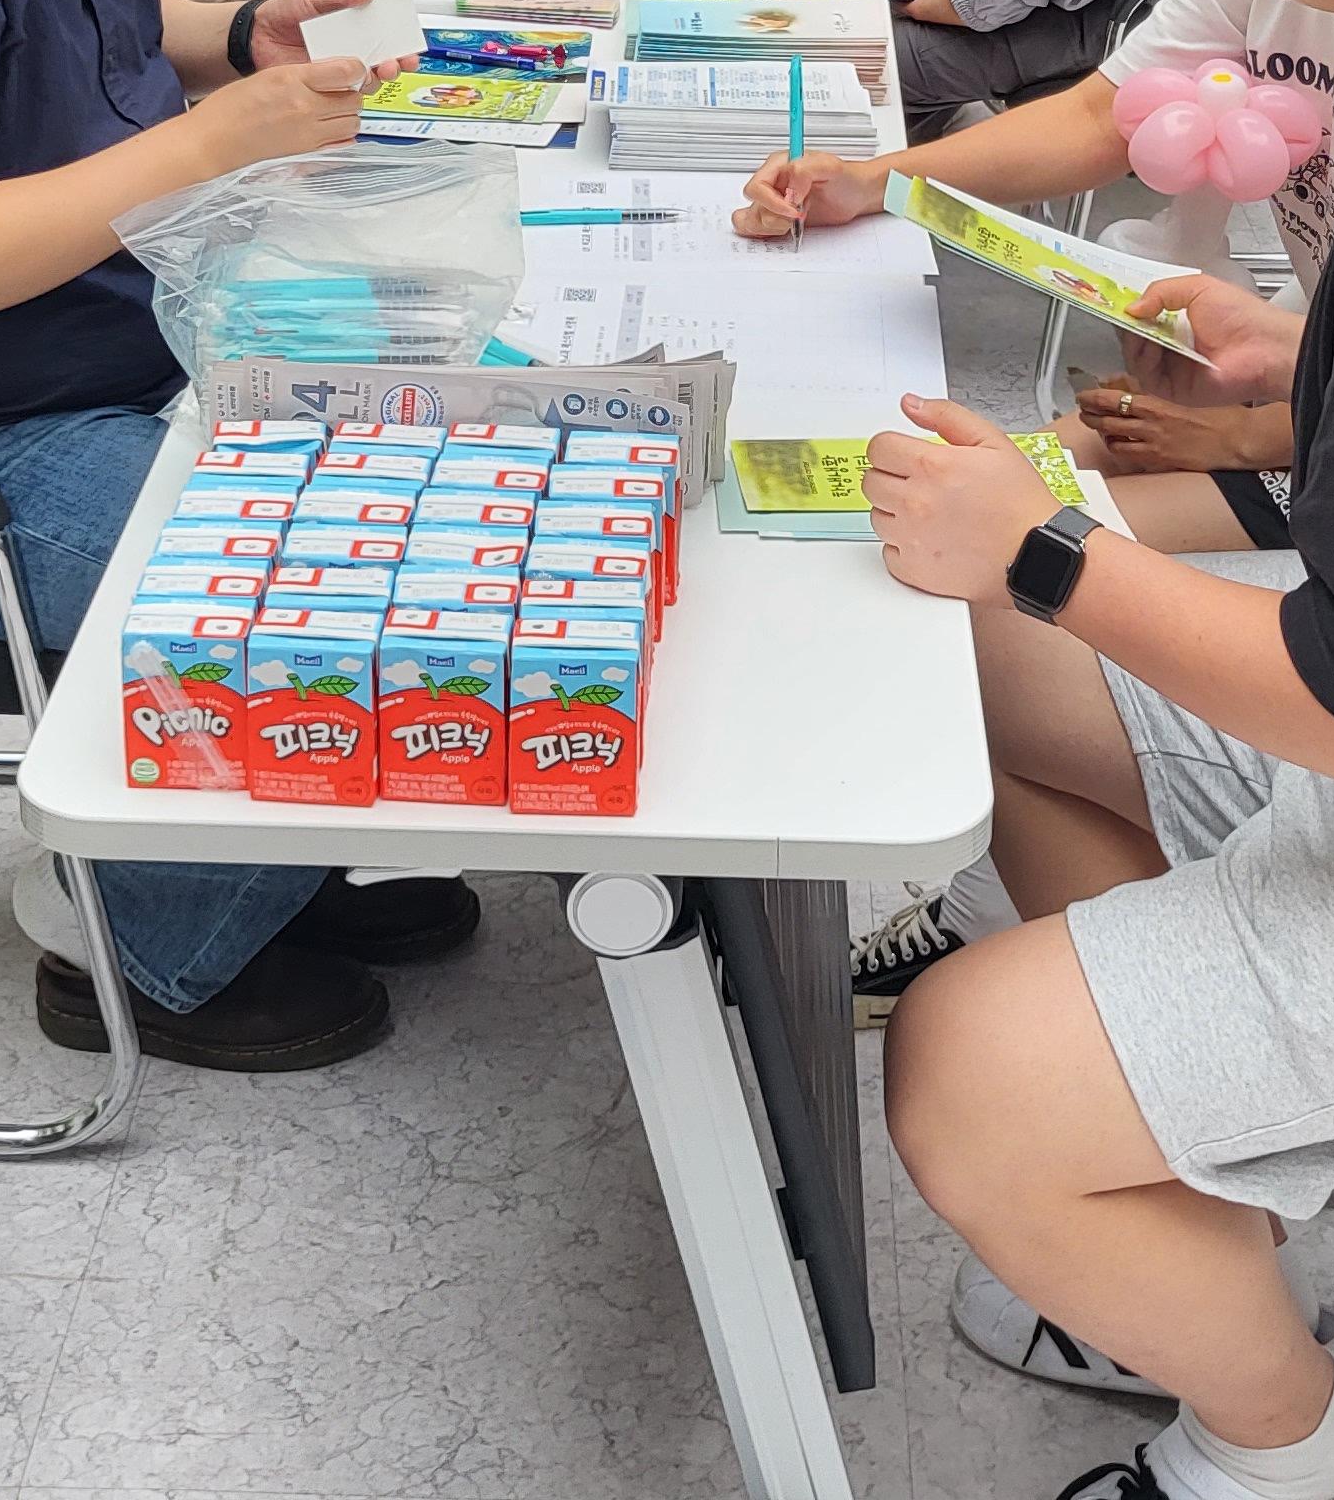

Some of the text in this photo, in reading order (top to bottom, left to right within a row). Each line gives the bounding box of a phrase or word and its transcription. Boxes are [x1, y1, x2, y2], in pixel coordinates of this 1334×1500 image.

[361, 383, 372, 408] MASK
[820, 454, 856, 498] 학생생활
[131, 706, 231, 747] Picnic
[259, 722, 360, 760] 피크닉
[390, 722, 491, 760] 피크닉
[309, 753, 339, 765] Apple
[440, 752, 470, 764] Apple
[520, 732, 623, 772] 피크닉
[571, 763, 602, 774] Apple
